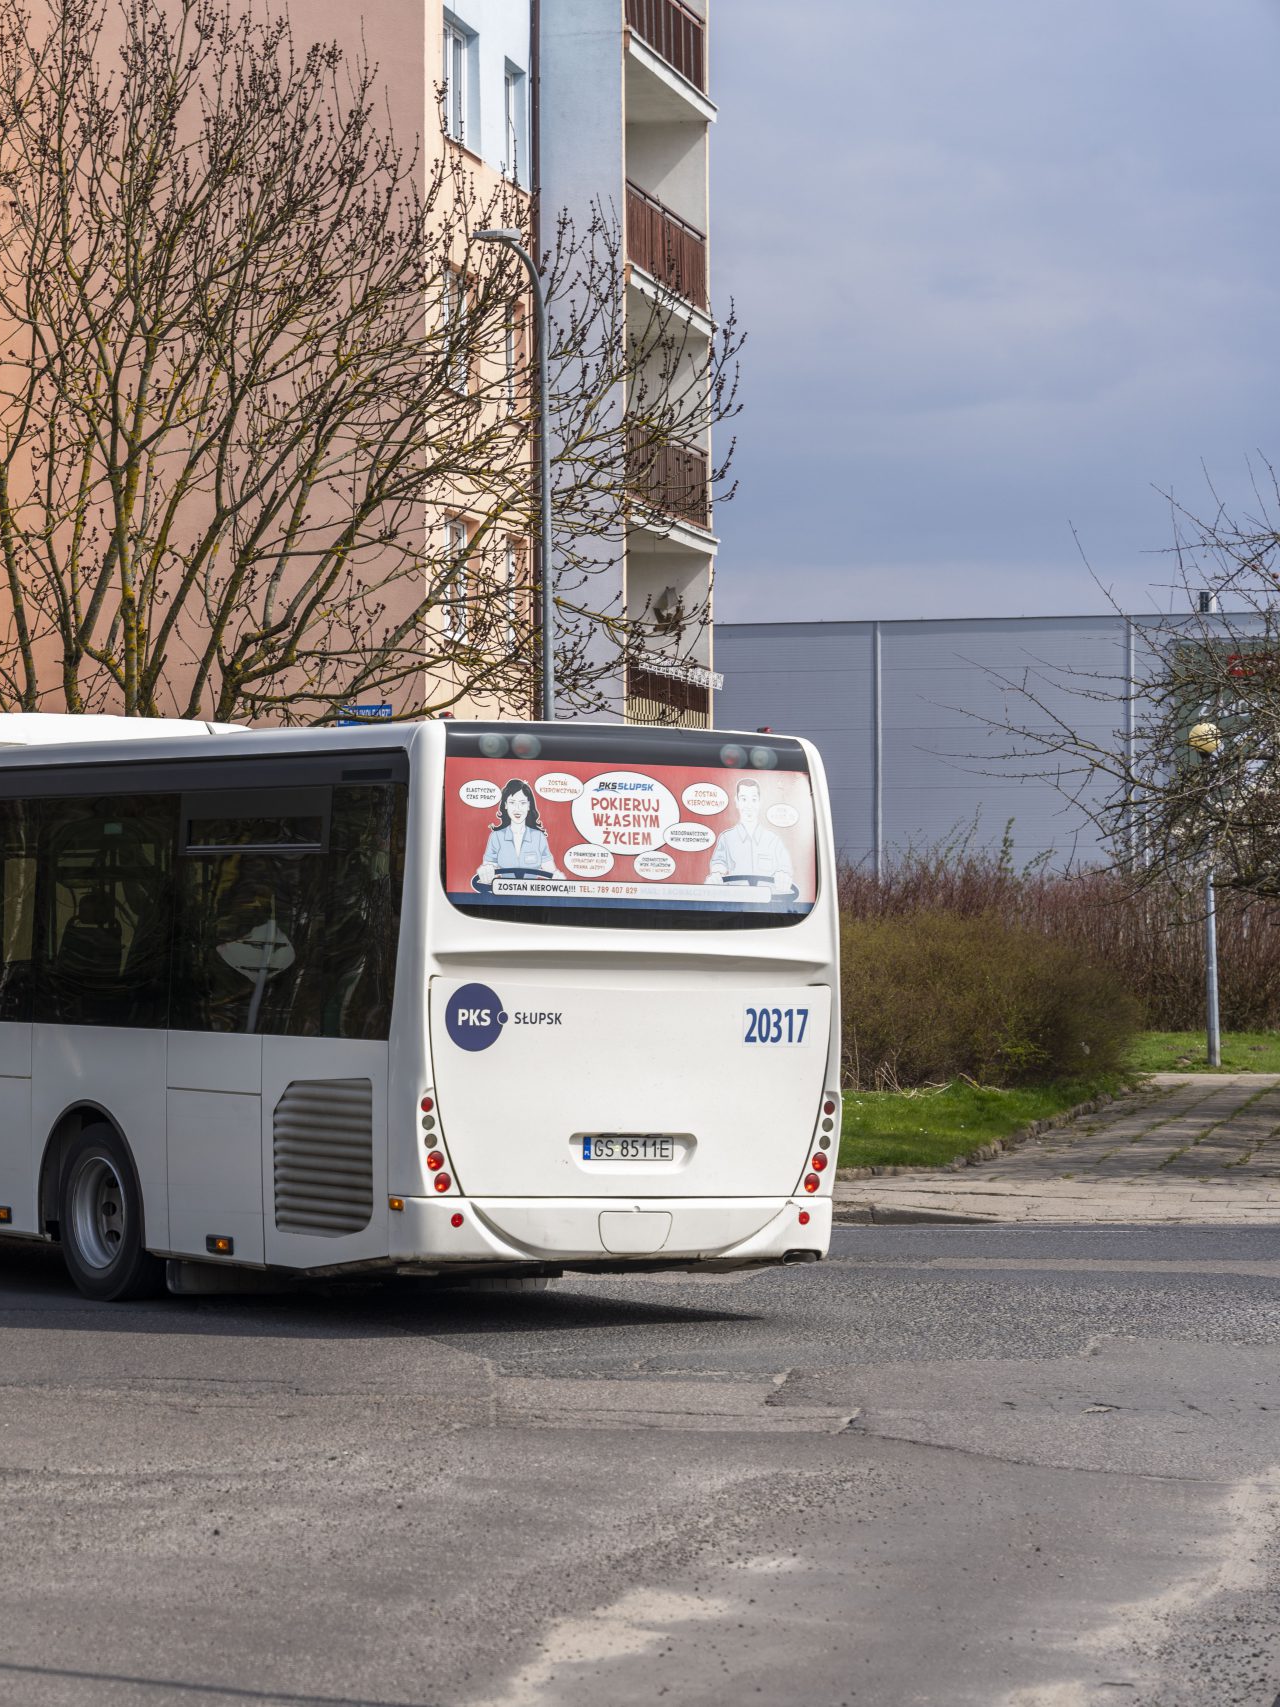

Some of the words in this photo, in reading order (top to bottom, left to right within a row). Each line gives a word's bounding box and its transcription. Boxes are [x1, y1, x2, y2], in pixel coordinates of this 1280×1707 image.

[591, 797, 660, 812] POKIERUJ
[593, 813, 660, 828] WŁASNYM
[602, 827, 652, 846] ŻYCIEM
[498, 882, 528, 892] ZOSTAŃ
[530, 884, 576, 894] KIEROWCĄ!!!
[597, 886, 610, 894] 789
[457, 1008, 491, 1027] PKS
[514, 1012, 562, 1025] SŁUPSK
[744, 1008, 809, 1043] 20317
[594, 1139, 615, 1158] GS
[620, 1139, 670, 1158] 8511E
